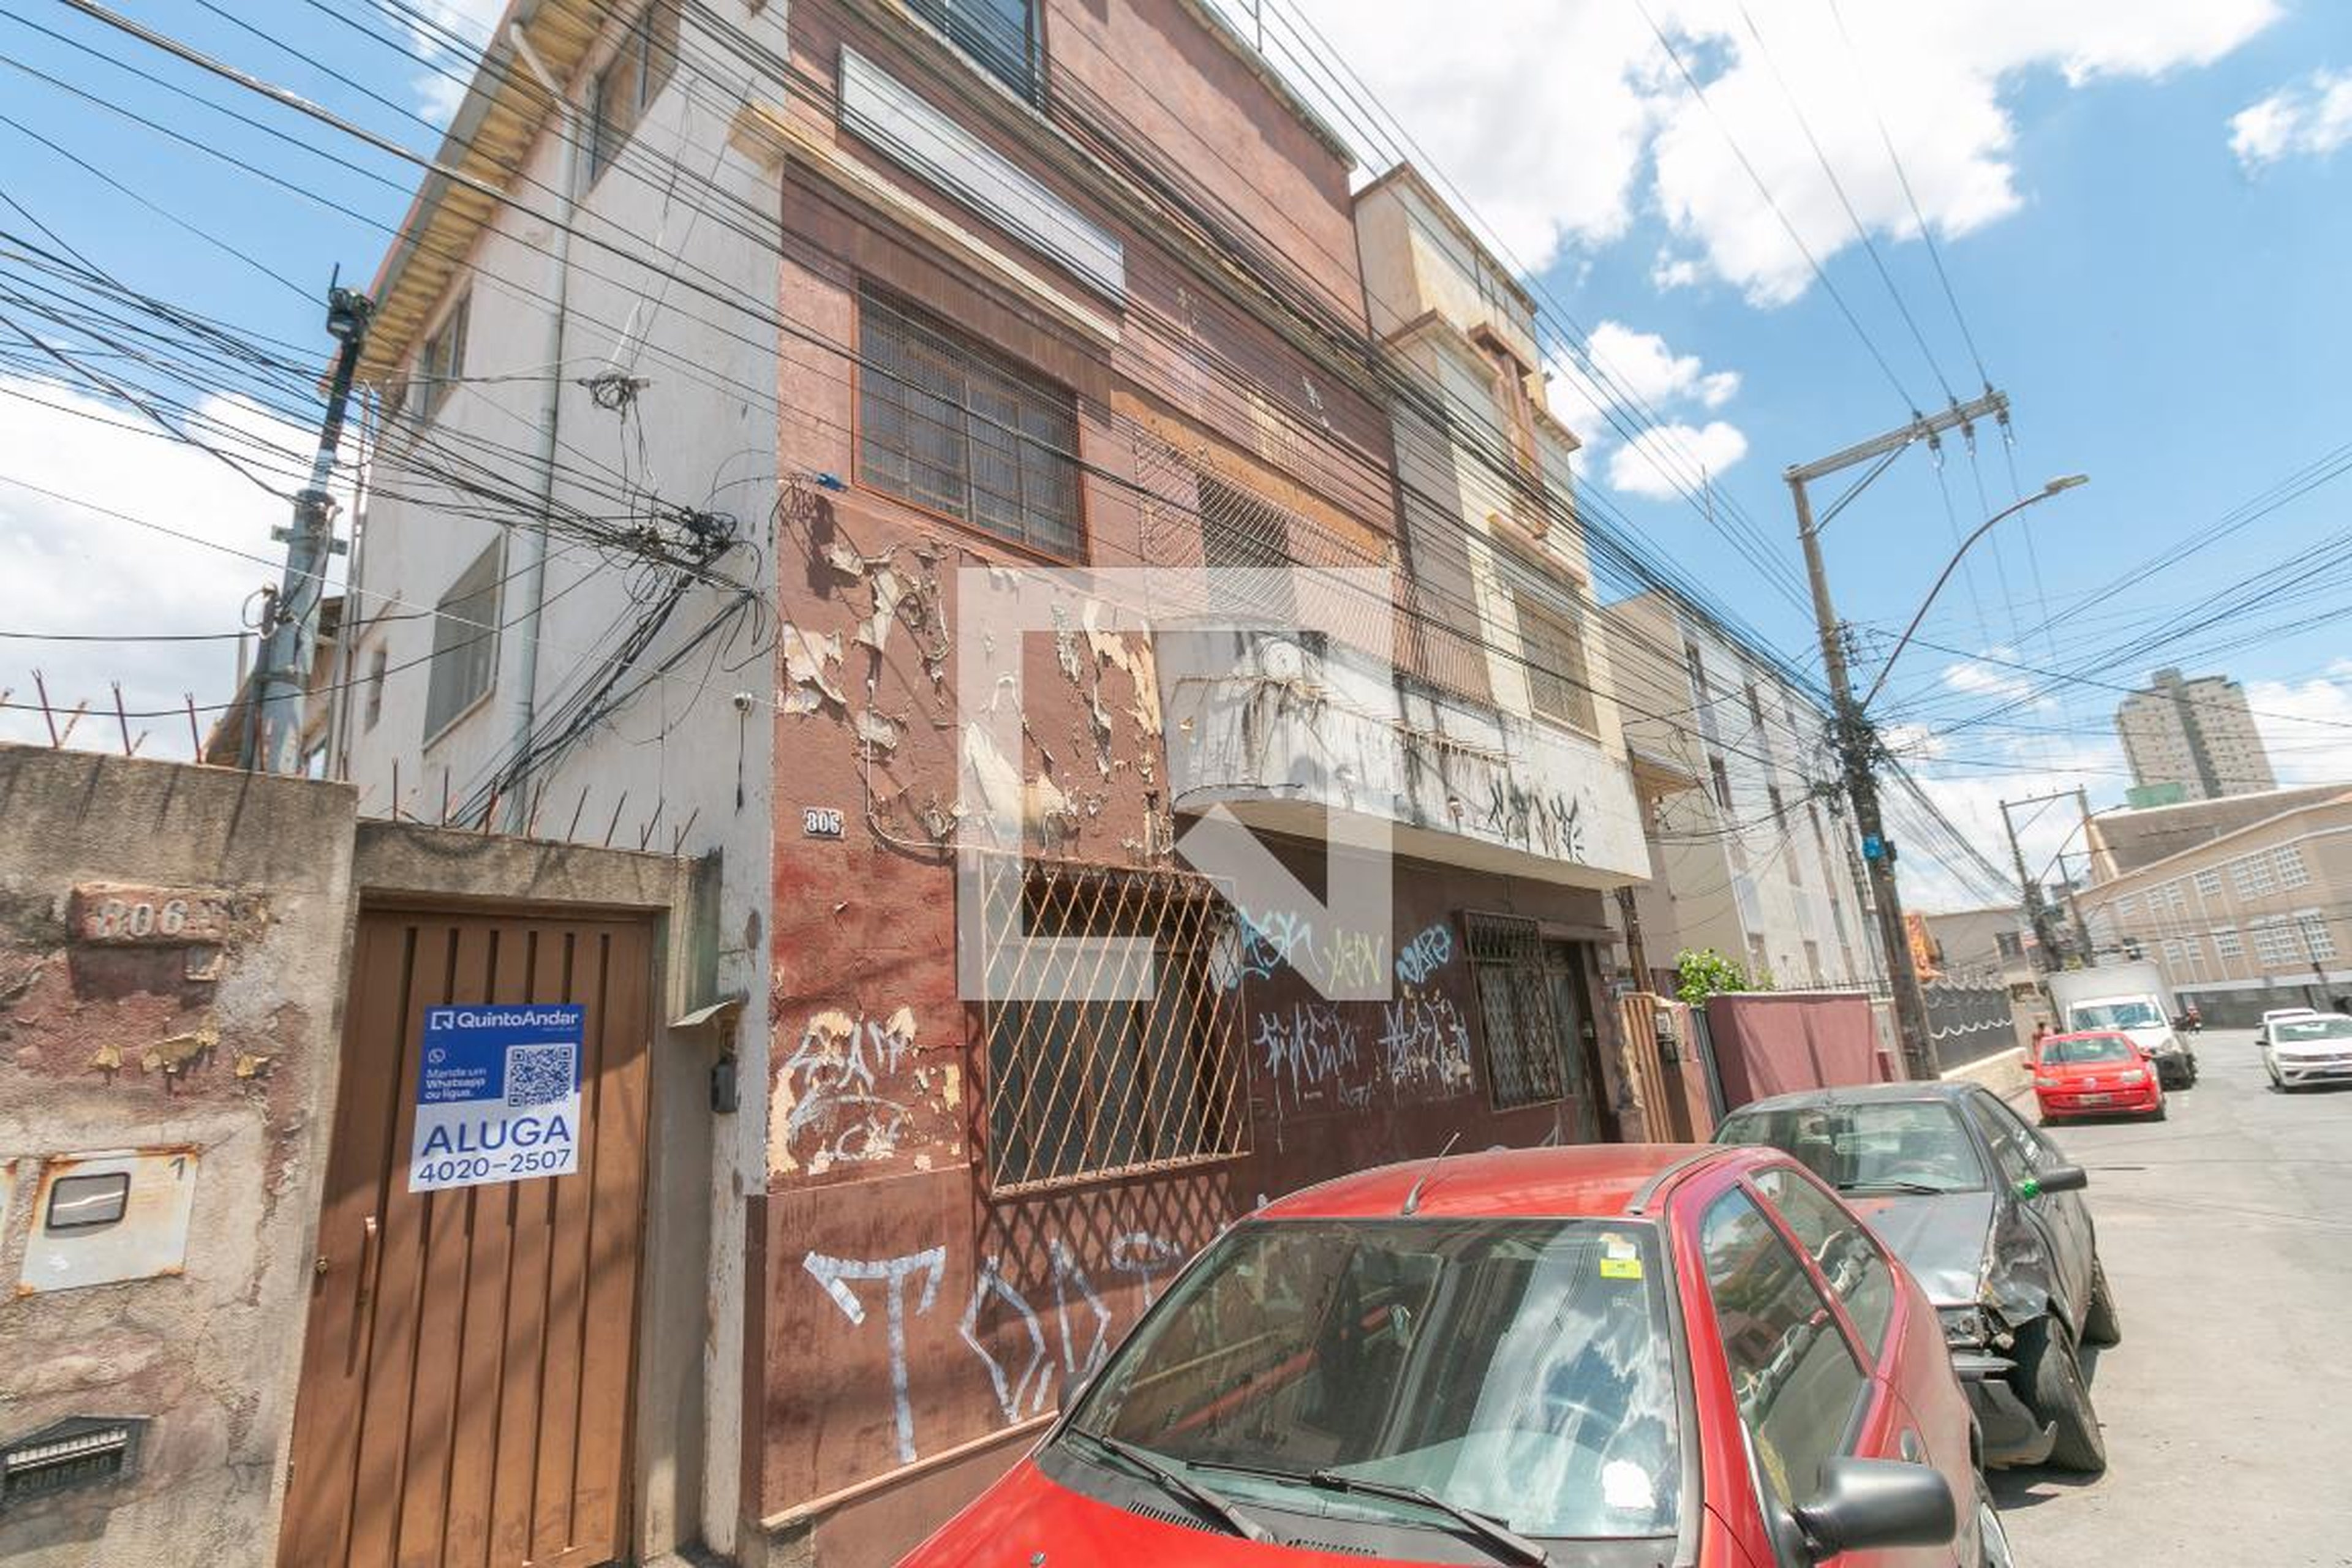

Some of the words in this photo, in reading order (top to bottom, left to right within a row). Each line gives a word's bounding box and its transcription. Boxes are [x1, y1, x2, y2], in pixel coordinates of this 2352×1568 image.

[807, 812, 840, 834] 806
[97, 898, 189, 937] 806
[457, 1010, 579, 1028] QuintoAndar
[421, 1115, 571, 1157] ALUGA
[168, 1157, 186, 1181] 1
[418, 1149, 571, 1183] 4020-2507
